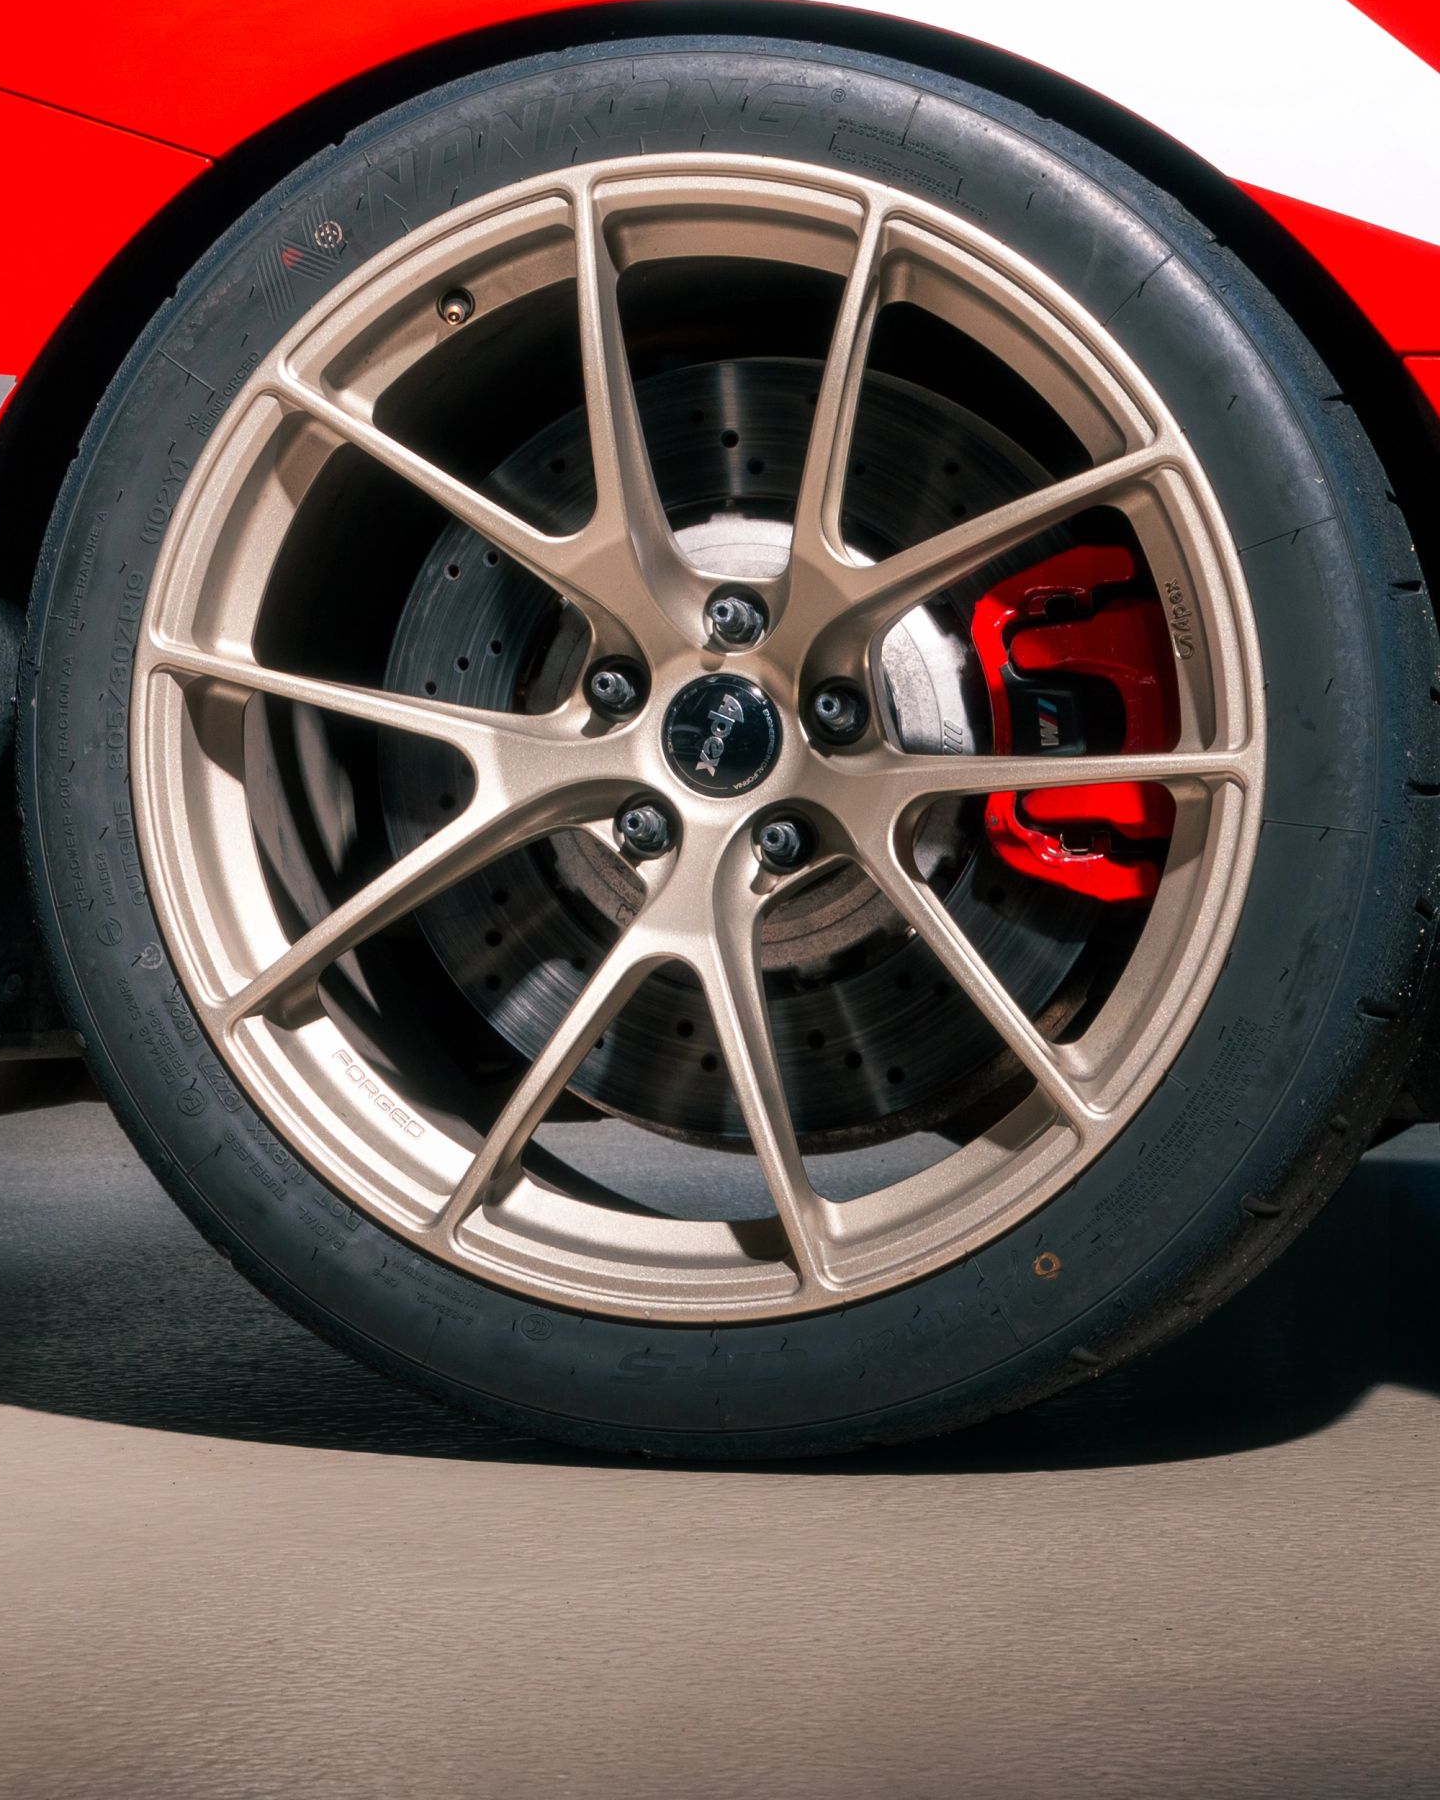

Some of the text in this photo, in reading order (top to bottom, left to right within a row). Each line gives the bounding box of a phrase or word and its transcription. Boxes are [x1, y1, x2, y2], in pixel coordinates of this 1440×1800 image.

[196, 349, 261, 438] REINFORCED
[64, 524, 104, 639] TEMPERATURE
[59, 653, 74, 676] AA
[105, 568, 148, 771] 305/30ZR19
[57, 683, 71, 761] TRACTION
[58, 775, 72, 810] 200
[61, 814, 89, 912] TREADWEAR
[112, 797, 147, 908] OUTSIDE
[330, 1048, 426, 1141] FORGED
[293, 1204, 345, 1253] RADIAL
[312, 1190, 363, 1233] DOT
